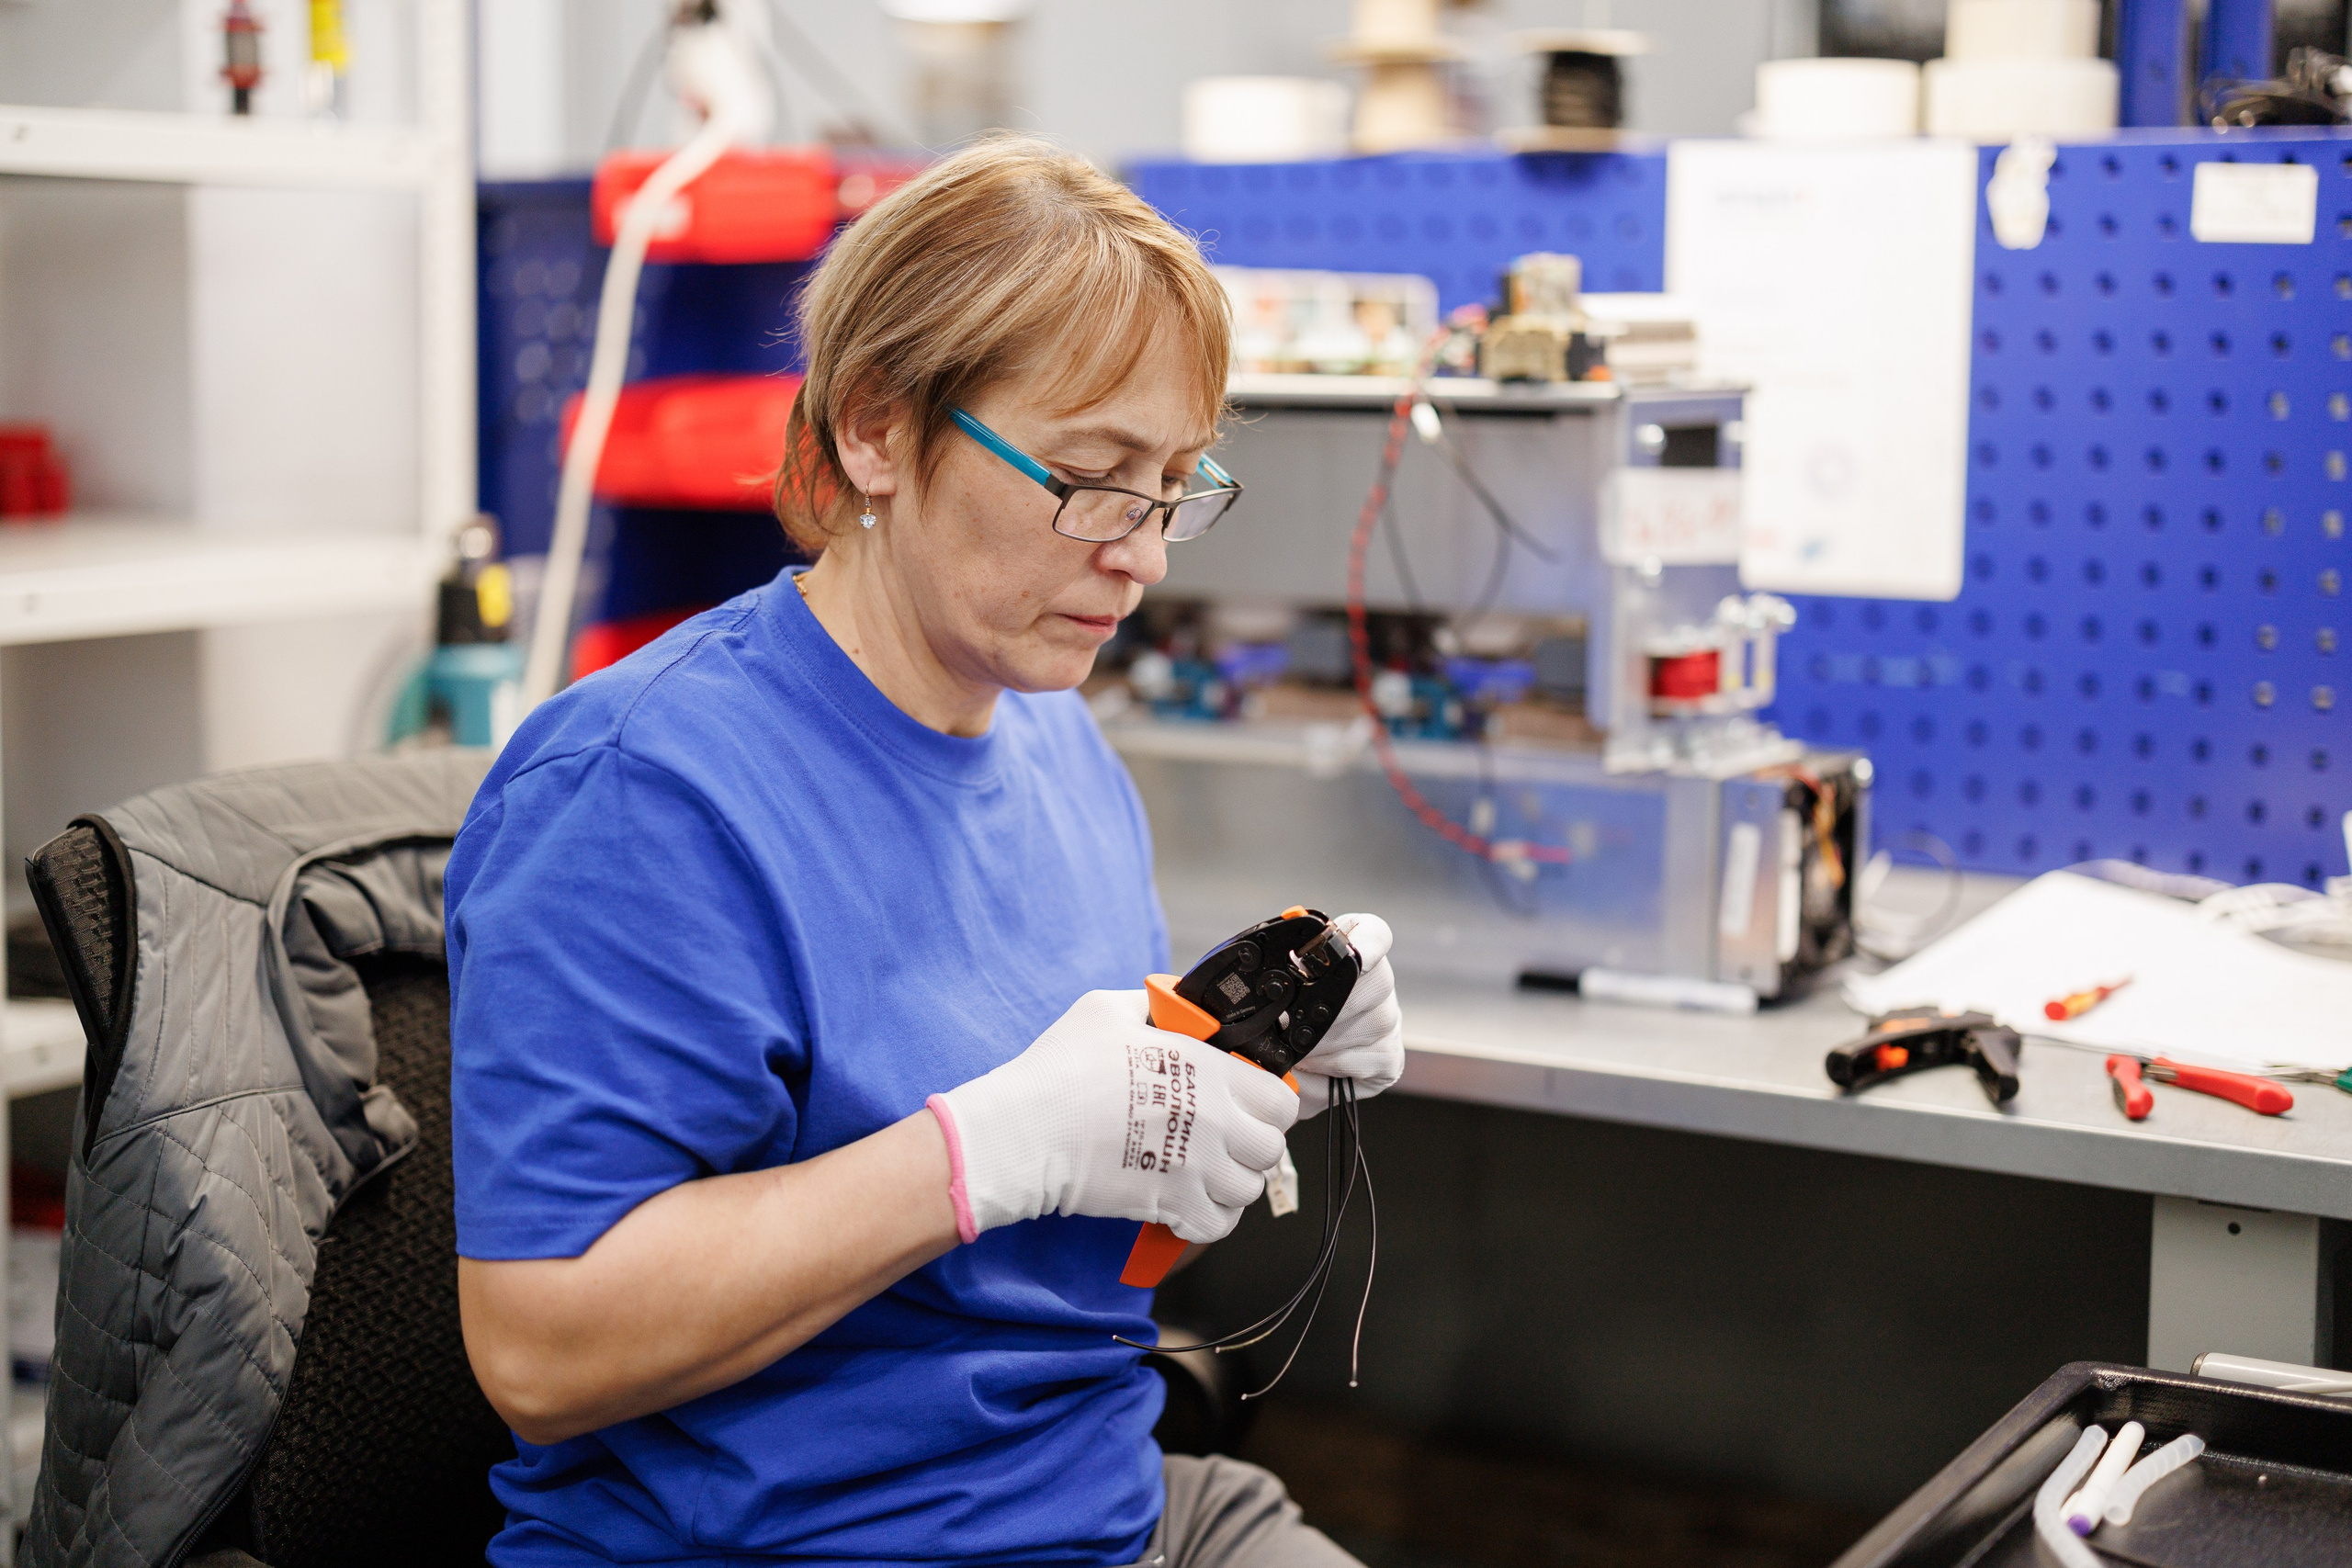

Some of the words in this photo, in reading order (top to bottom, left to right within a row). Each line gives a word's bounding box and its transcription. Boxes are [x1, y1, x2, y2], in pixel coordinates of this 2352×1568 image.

[1239, 1006, 1256, 1014] Germany
[1159, 1049, 1182, 1174] ЭВОЛЮШН
[1176, 1062, 1196, 1168] БАНТИНГ
[1140, 1150, 1158, 1170] 6
